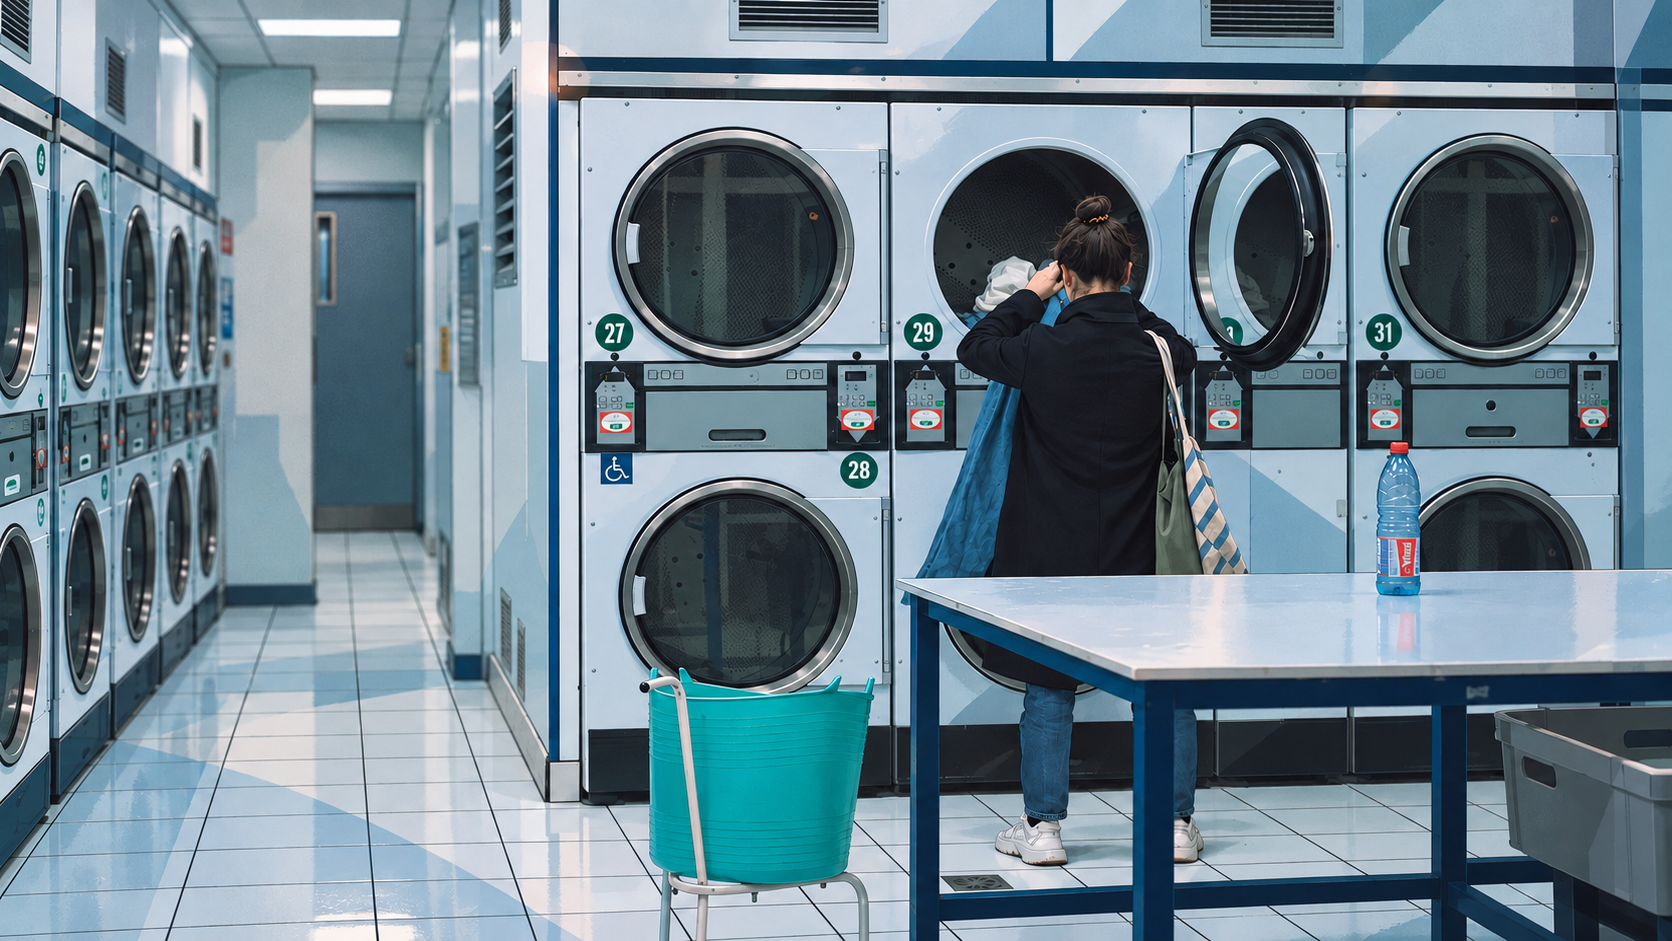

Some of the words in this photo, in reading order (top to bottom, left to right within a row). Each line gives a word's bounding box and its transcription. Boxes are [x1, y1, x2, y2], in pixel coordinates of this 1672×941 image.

[604, 322, 625, 343] 27
[913, 322, 934, 342] 29
[1374, 322, 1392, 343] 31
[848, 460, 870, 480] 28
